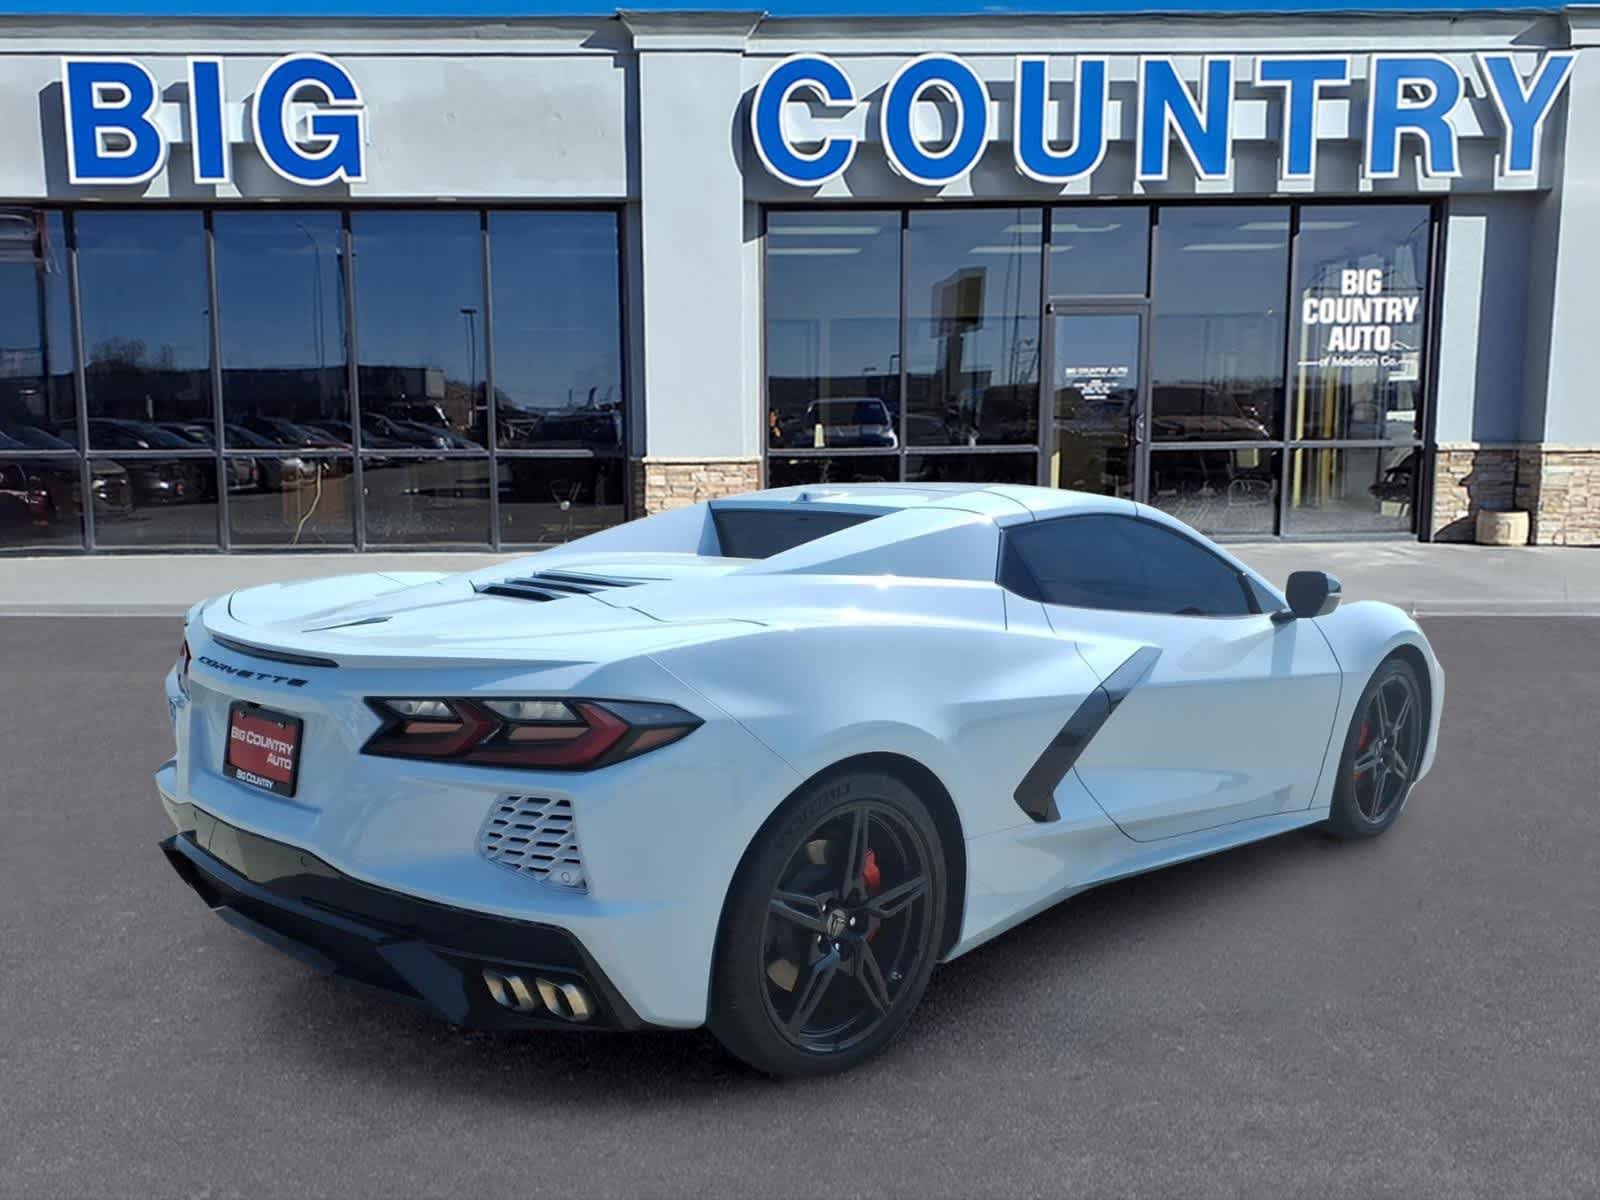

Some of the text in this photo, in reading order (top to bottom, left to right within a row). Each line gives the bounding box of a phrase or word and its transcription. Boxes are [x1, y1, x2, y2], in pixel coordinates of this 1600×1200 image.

[60, 52, 1575, 187] BIG COUNTRY
[1341, 268, 1382, 296] BIG
[1302, 297, 1420, 324] COUNTRY
[1327, 325, 1391, 352] AUTO
[198, 656, 309, 687] CORVETTE
[231, 726, 294, 755] BIG COUNTRY
[266, 753, 292, 770] AUTO
[236, 769, 274, 789] BIG COUNTRY
